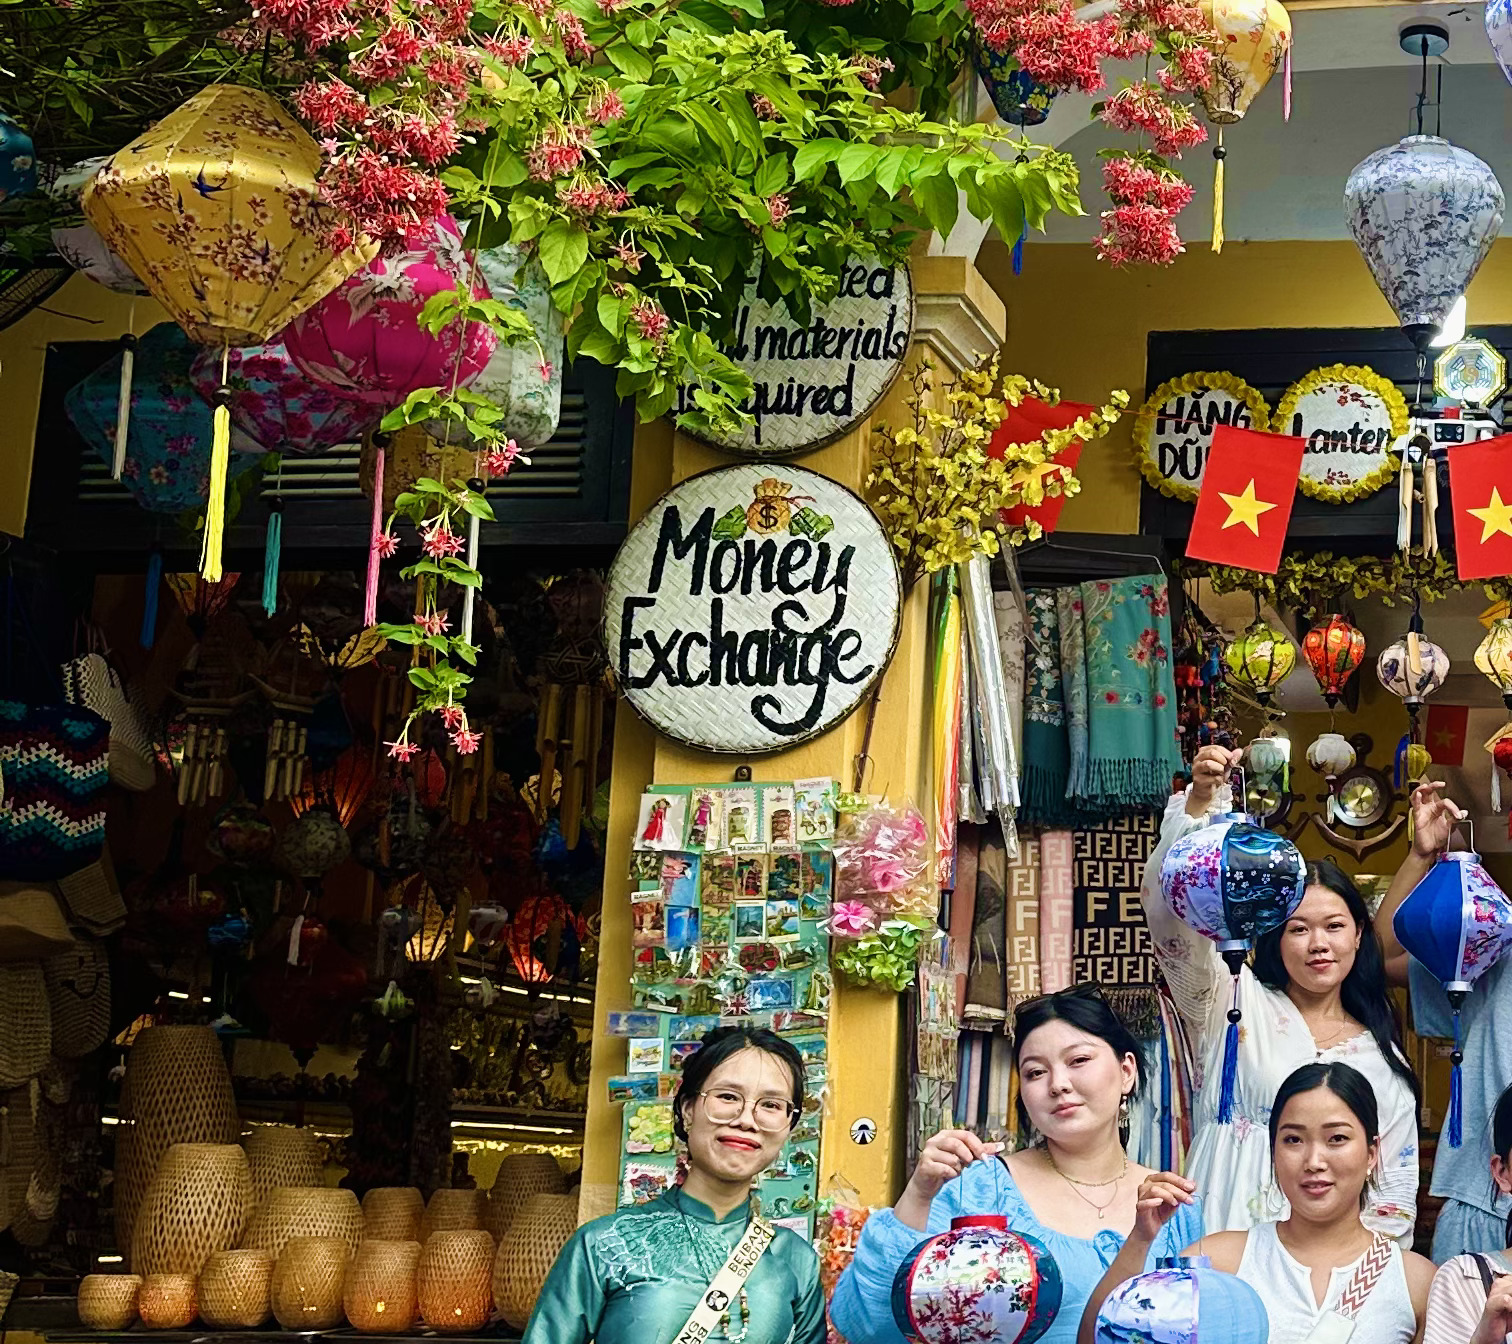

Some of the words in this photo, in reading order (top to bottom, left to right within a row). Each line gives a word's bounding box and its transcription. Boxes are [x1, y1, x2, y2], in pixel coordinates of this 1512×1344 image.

[753, 304, 908, 362] materials
[648, 504, 857, 635] Money
[619, 596, 873, 737] Exchange
